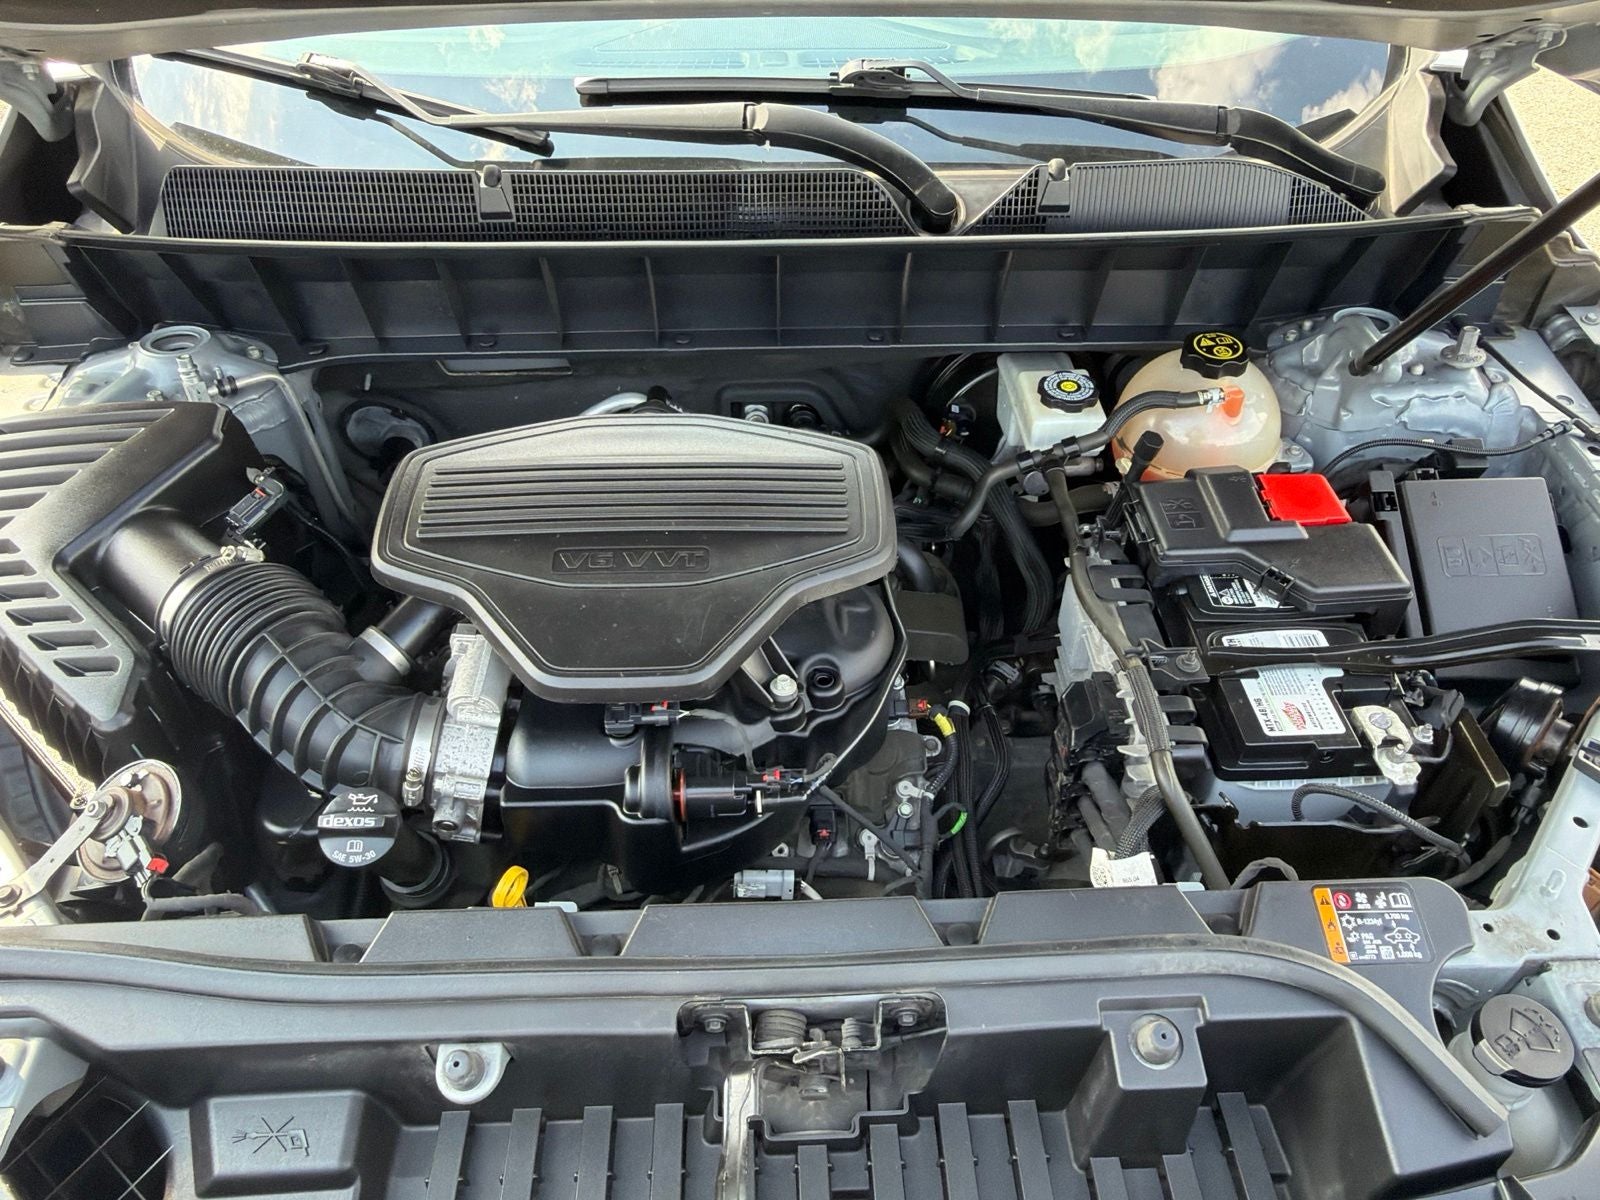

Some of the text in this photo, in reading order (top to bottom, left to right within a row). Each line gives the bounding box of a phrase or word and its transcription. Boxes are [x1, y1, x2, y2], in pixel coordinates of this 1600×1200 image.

[559, 551, 704, 569] V6 VVT
[322, 814, 376, 827] dexos
[332, 849, 377, 864] SAE 5W-30
